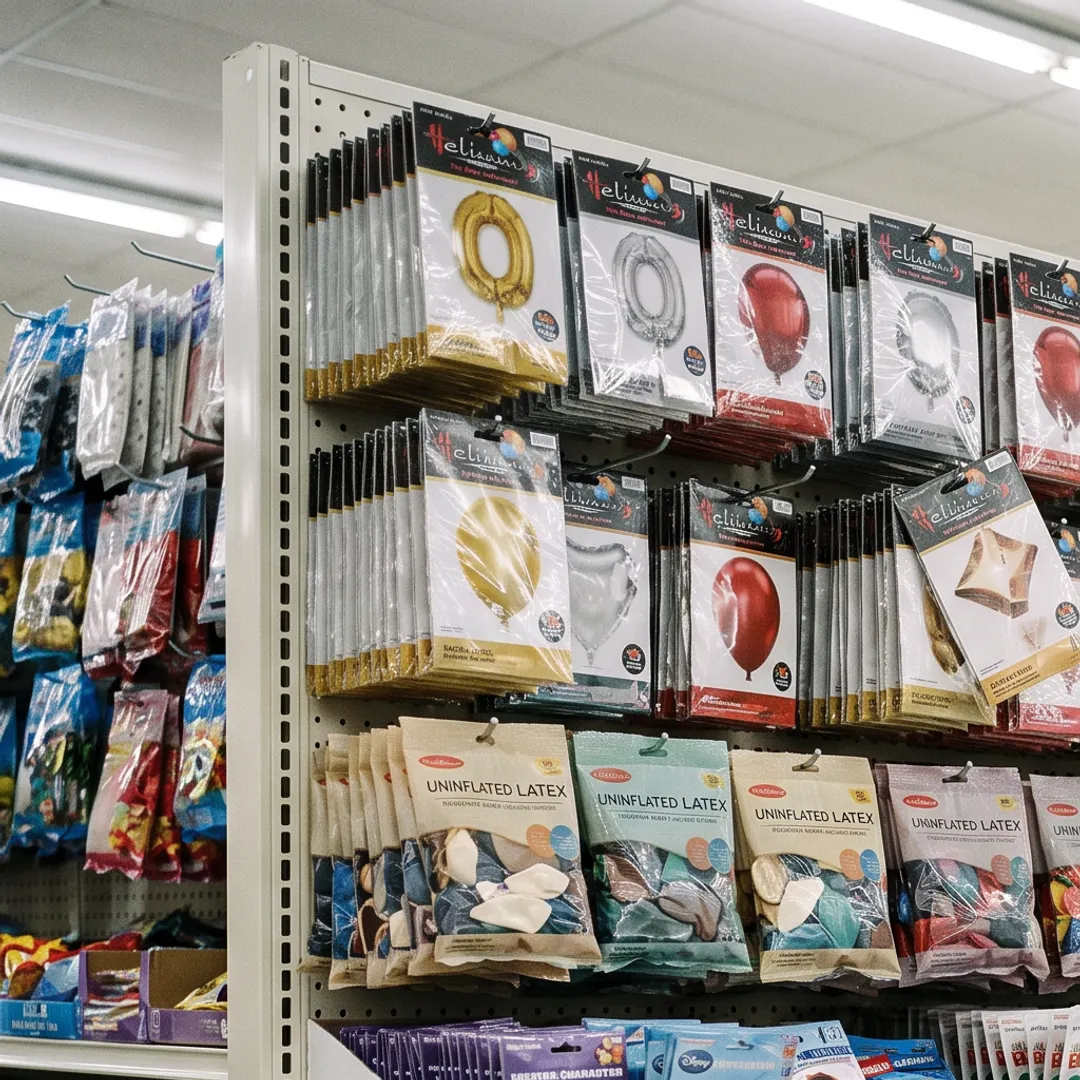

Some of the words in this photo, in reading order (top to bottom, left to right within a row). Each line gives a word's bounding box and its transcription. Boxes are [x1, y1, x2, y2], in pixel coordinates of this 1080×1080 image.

[427, 780, 513, 796] UNINFLATED
[516, 783, 568, 798] LATEX
[597, 793, 678, 809] UNINFLATED
[682, 797, 728, 812] LATEX
[755, 808, 829, 823] UNINFLATED
[832, 811, 875, 825] LATEX
[912, 817, 977, 831] UNINFLATED
[980, 819, 1022, 832] LATEX
